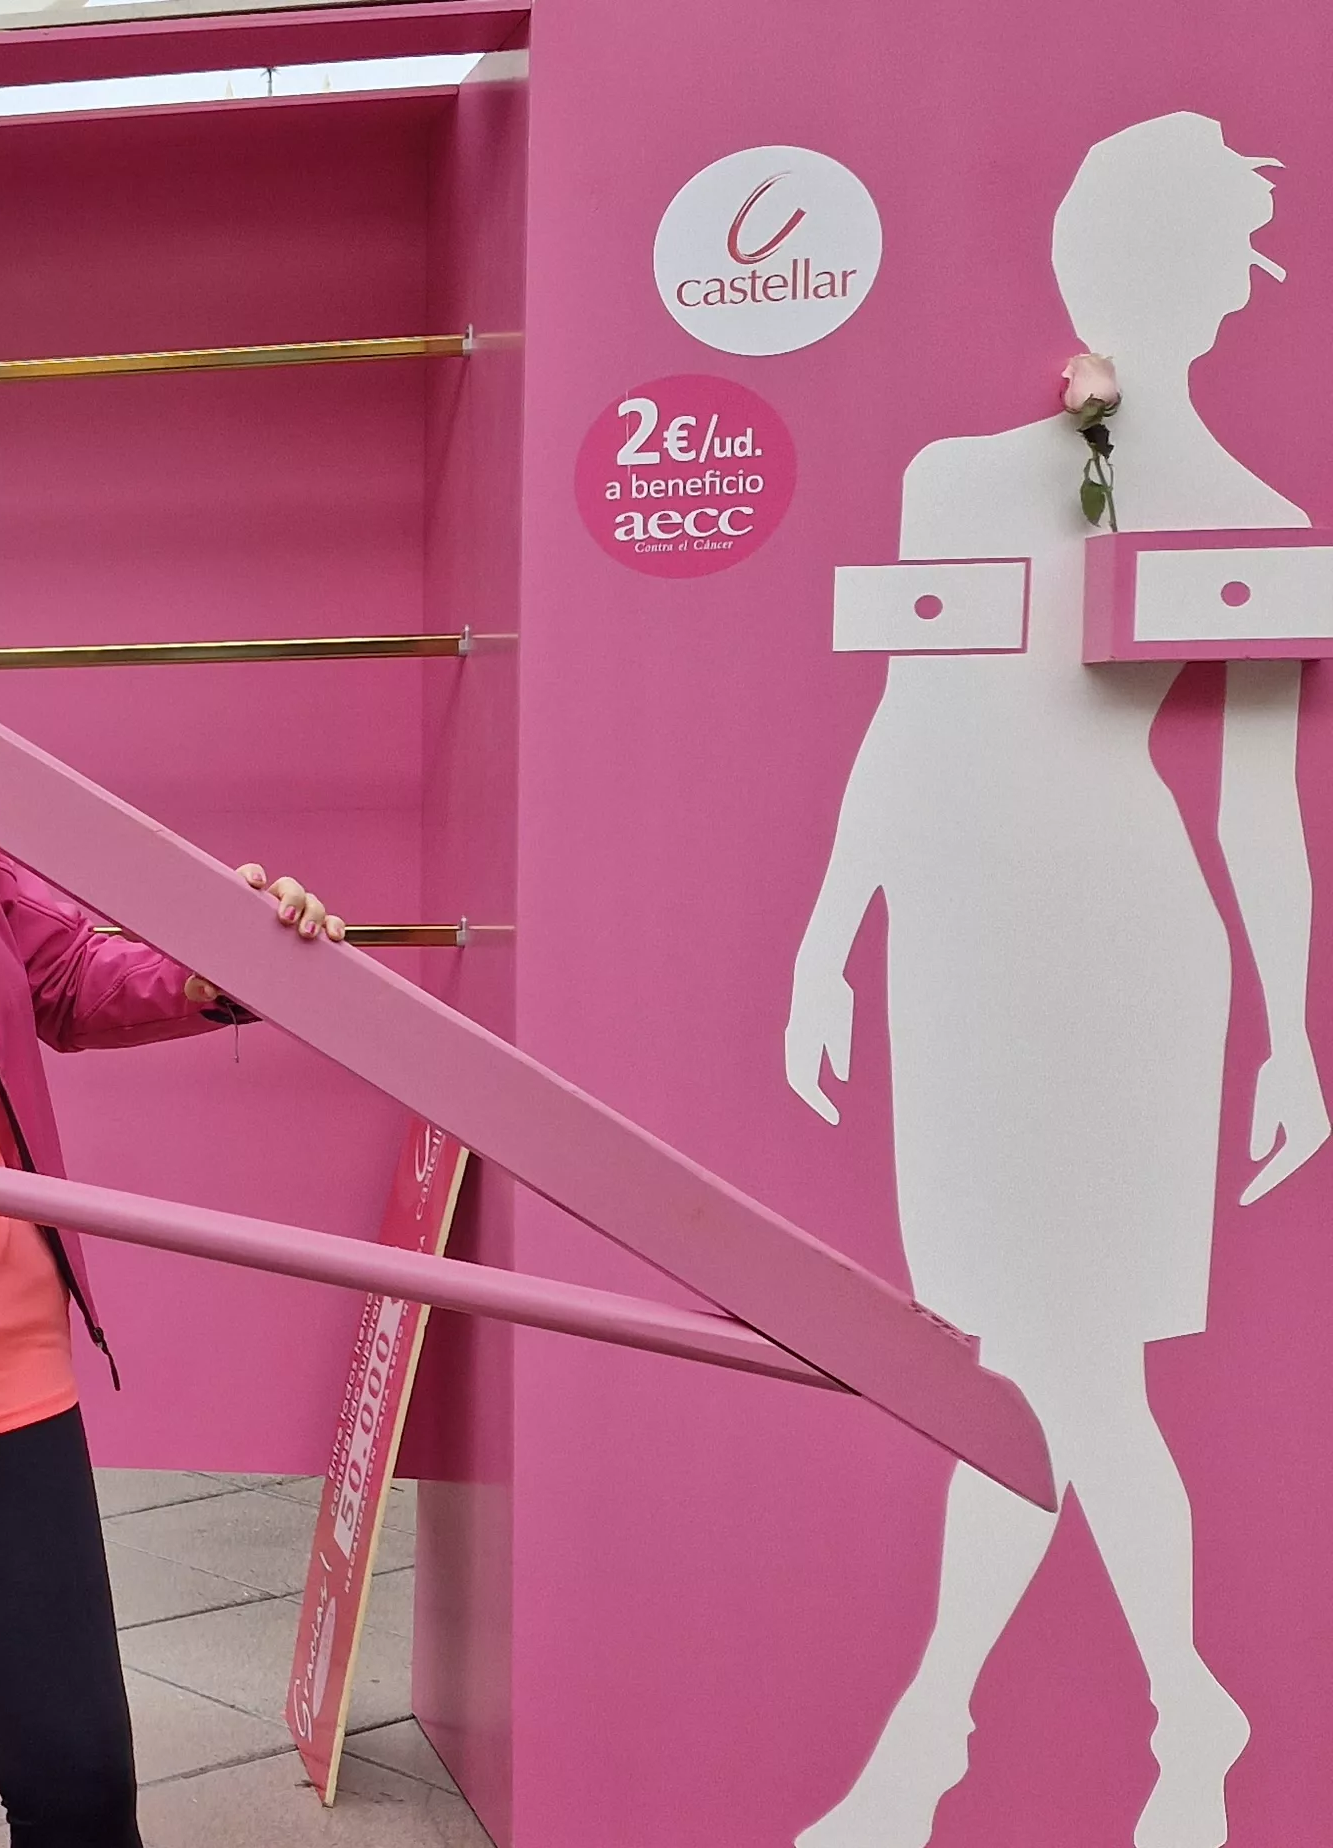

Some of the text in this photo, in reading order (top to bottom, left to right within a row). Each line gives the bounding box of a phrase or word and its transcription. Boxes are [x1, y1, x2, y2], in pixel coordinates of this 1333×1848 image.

[675, 257, 858, 308] castellar
[605, 469, 764, 500] a beneficio
[614, 506, 754, 541] aecc
[634, 539, 733, 553] Contra el Cáncer
[341, 1331, 390, 1532] 50.000
